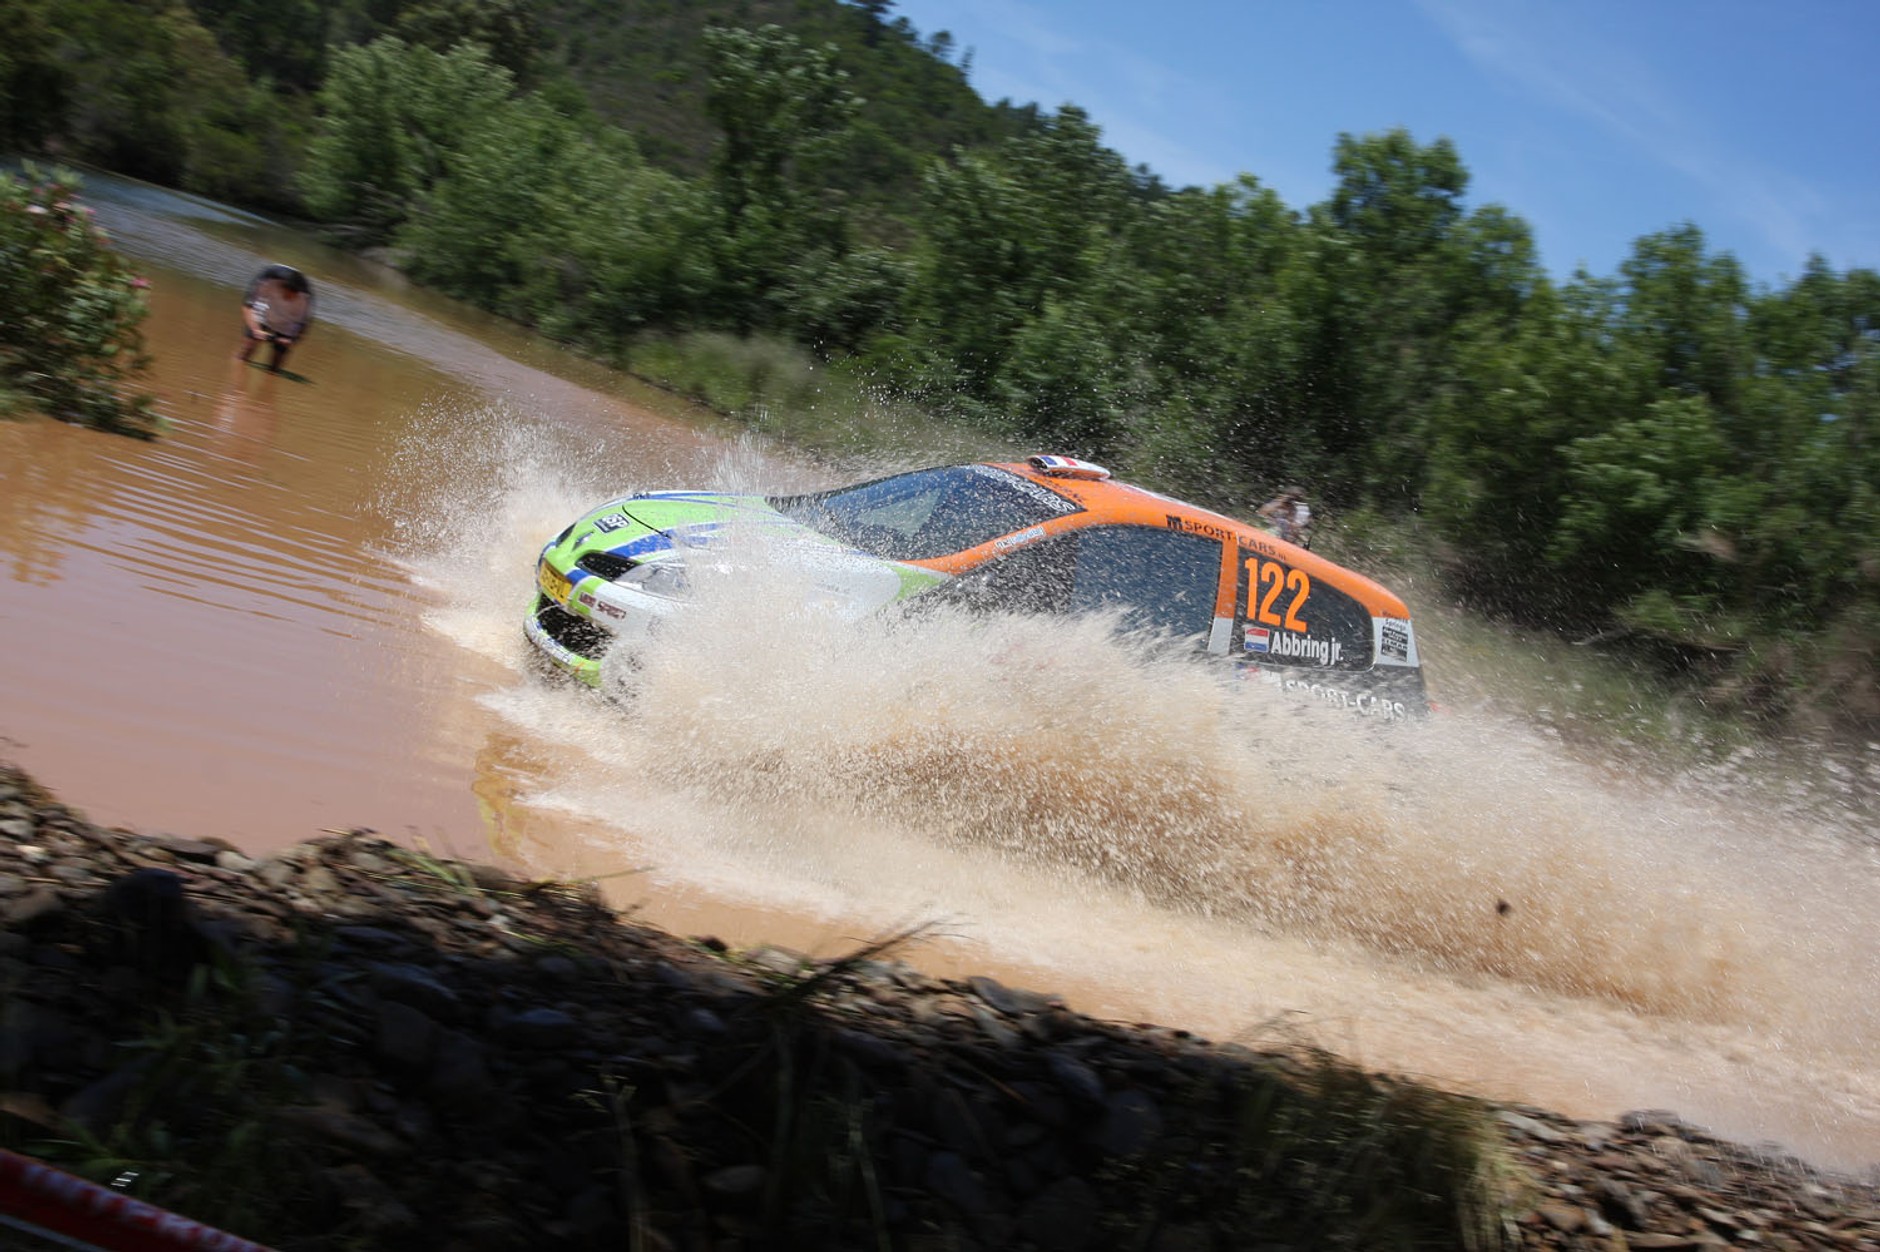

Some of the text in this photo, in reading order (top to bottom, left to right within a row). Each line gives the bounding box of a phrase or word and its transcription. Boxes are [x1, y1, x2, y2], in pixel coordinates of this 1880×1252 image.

[1244, 557, 1311, 633] 122
[1270, 631, 1344, 666] Abbring jr.
